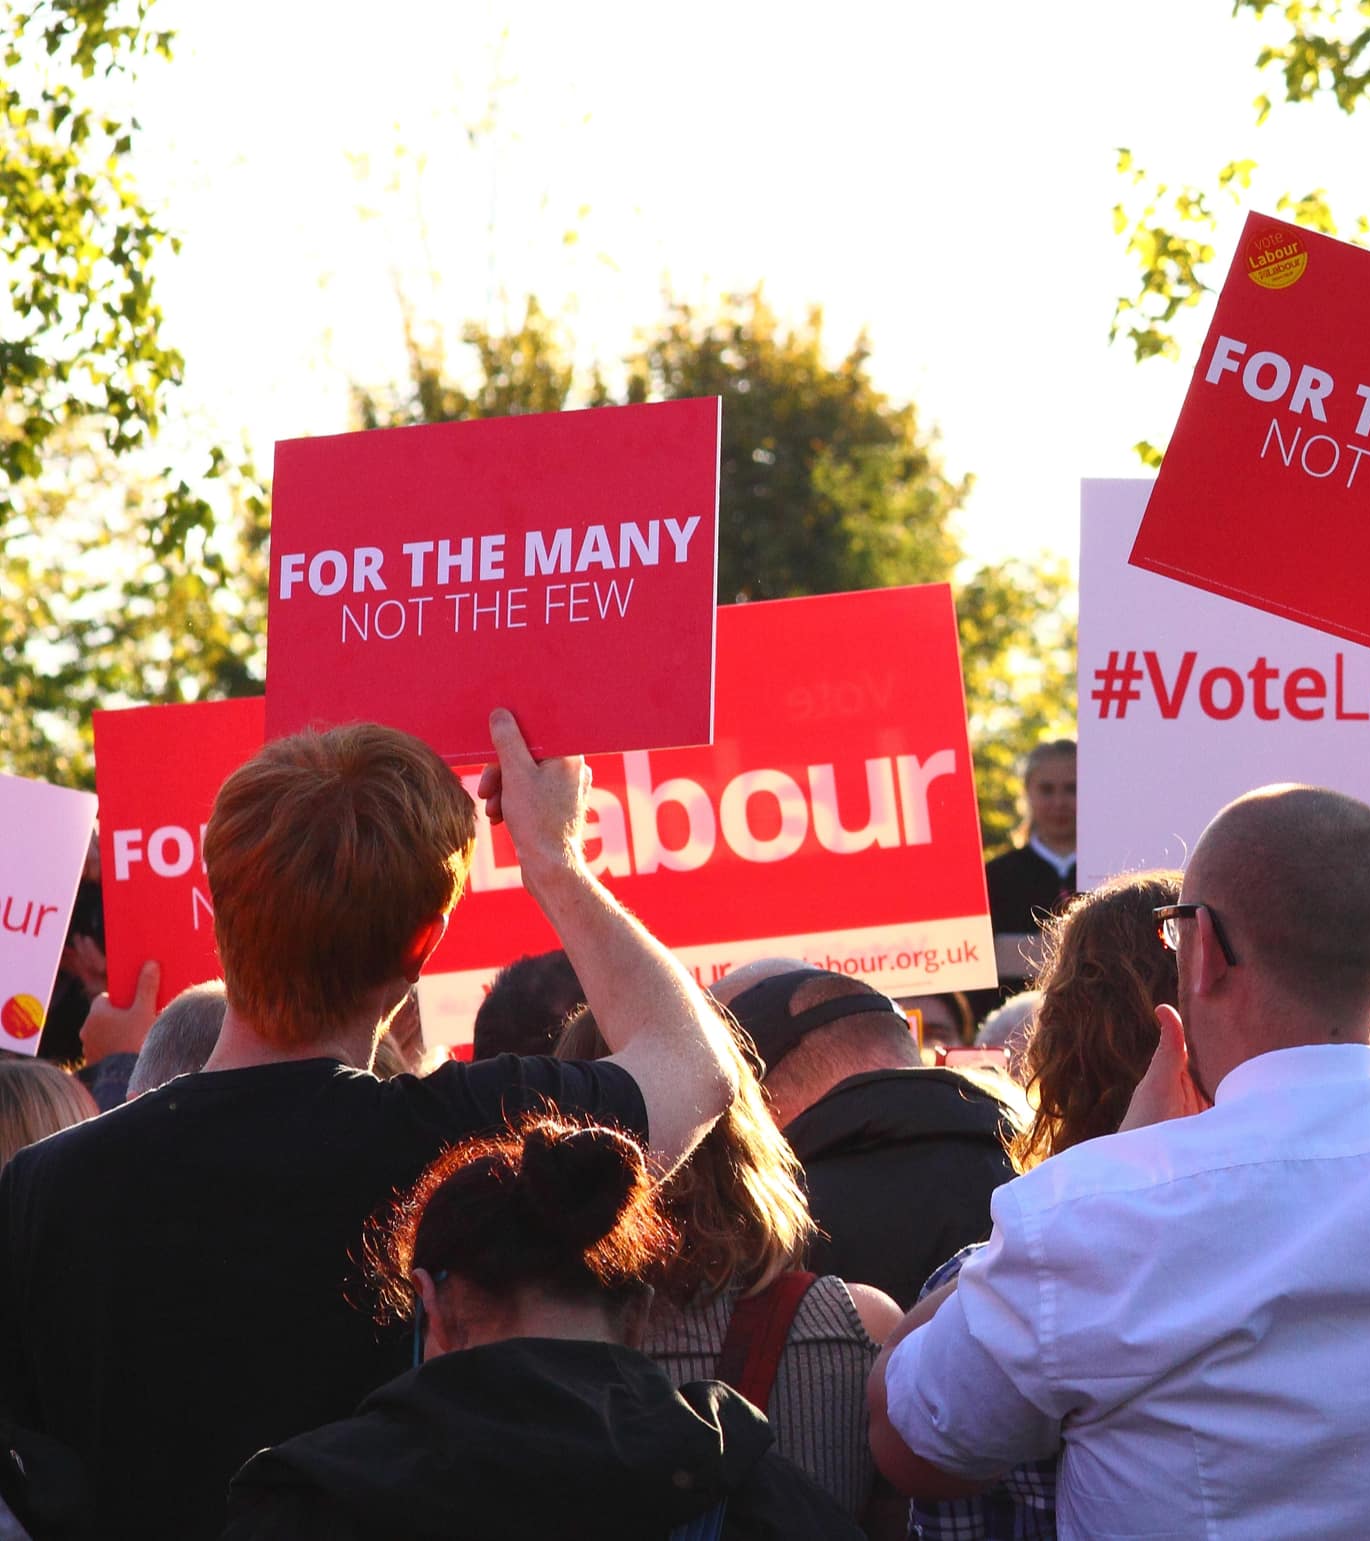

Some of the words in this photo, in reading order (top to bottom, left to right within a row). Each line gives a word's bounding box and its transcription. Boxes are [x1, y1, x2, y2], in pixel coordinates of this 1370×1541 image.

[1248, 242, 1299, 269] Labour
[1205, 335, 1334, 423] FOR
[279, 546, 387, 600] FOR
[402, 534, 506, 588] THE
[524, 515, 702, 577] MANY
[341, 596, 433, 644] NOT
[445, 588, 528, 633] THE
[545, 578, 635, 625] FEW
[113, 824, 208, 882] FO
